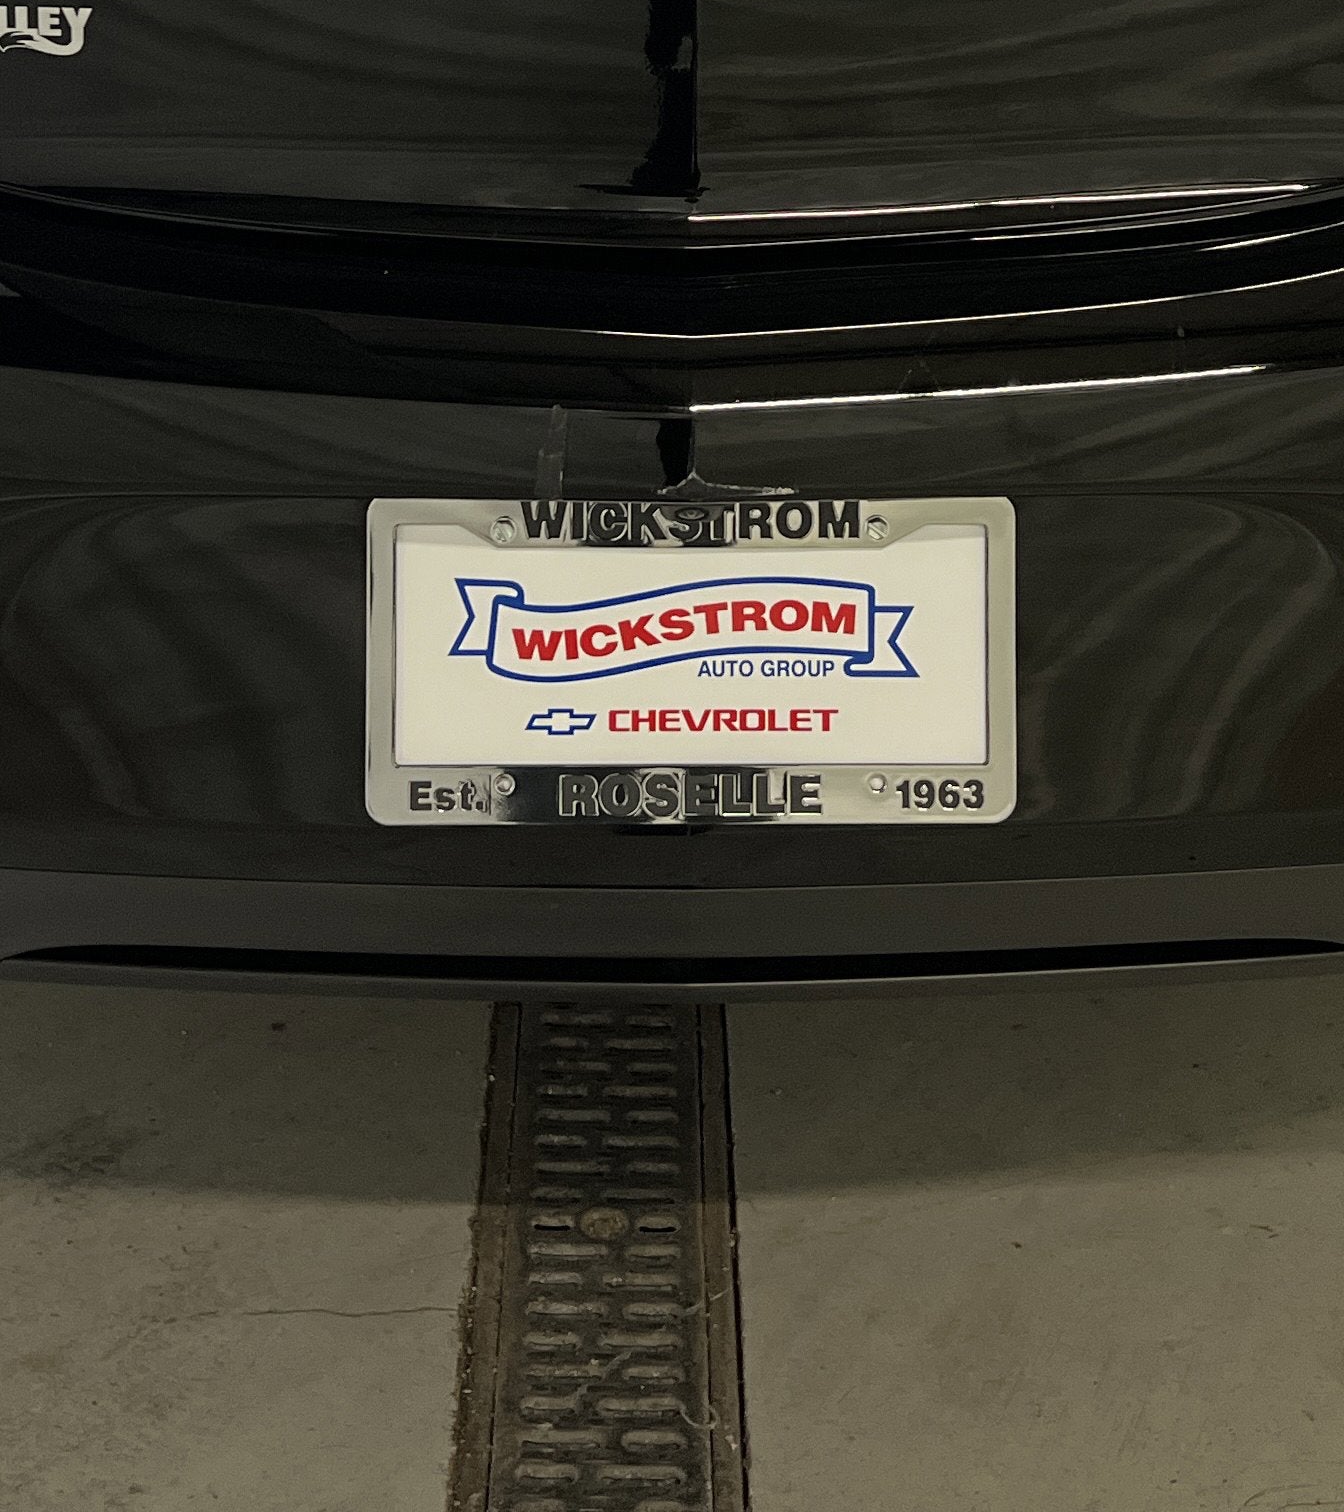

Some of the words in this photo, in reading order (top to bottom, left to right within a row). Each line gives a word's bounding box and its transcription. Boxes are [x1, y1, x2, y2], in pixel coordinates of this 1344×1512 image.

[520, 500, 861, 542] WICKSTROM
[511, 599, 857, 662] WICKSTROM
[697, 660, 753, 678] AUTO
[759, 660, 836, 678] GROUP
[607, 709, 839, 733] CHEVROLET
[408, 779, 486, 813] Est.
[557, 775, 823, 817] ROSELLE
[896, 780, 986, 810] 1963
